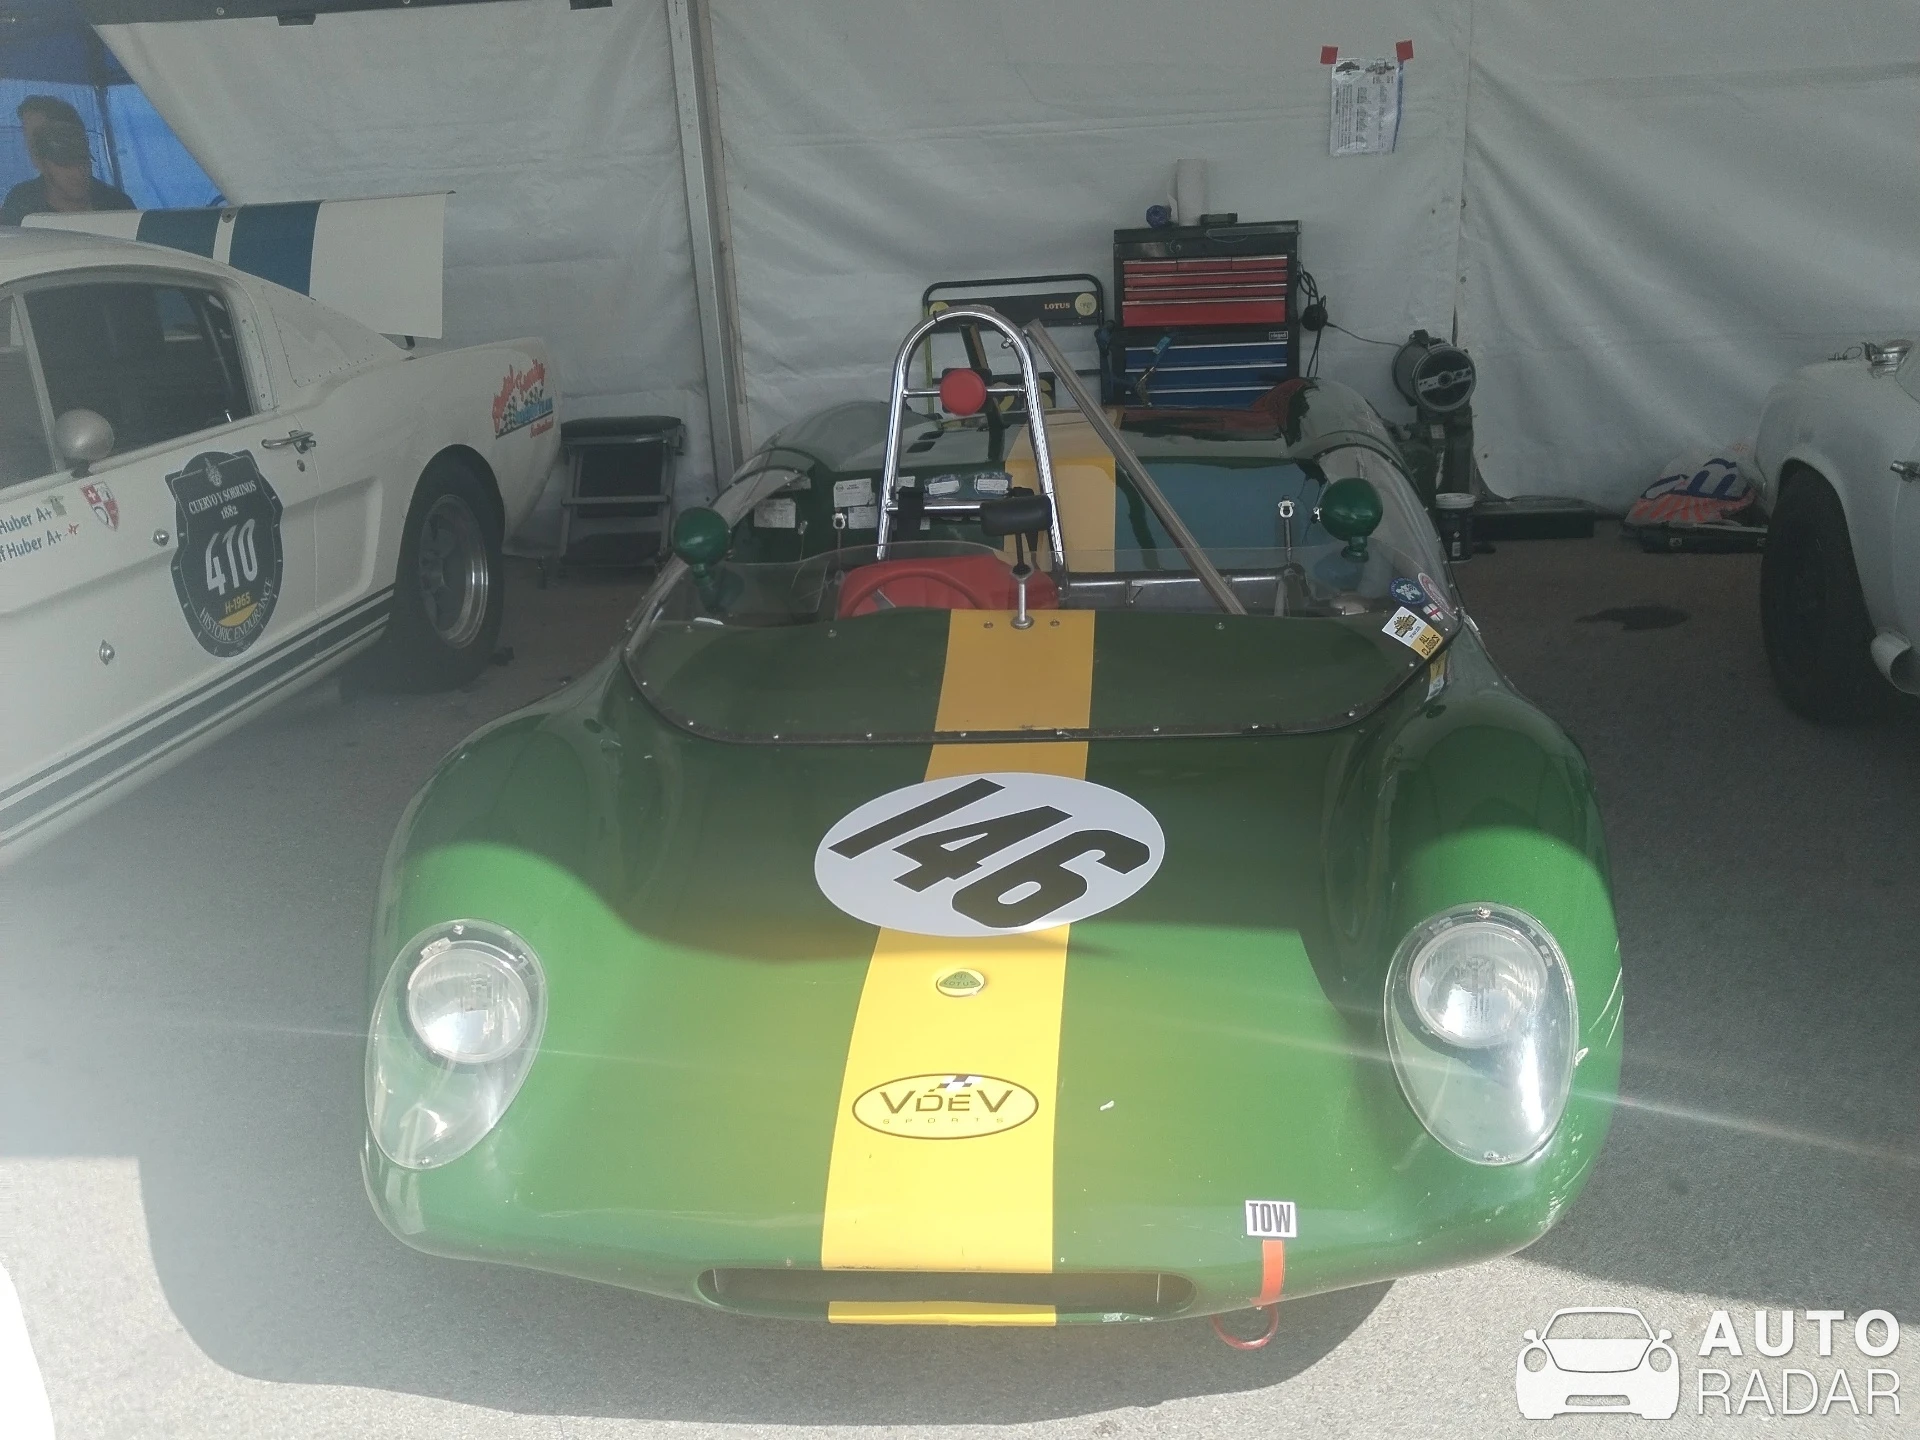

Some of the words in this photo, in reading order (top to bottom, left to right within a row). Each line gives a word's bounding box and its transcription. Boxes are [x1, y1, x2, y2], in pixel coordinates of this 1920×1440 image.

[1044, 302, 1070, 310] LOTUS
[188, 492, 218, 514] CUERVO
[223, 480, 257, 502] SOBRINOS
[36, 507, 52, 522] A+
[221, 505, 238, 519] 1882
[6, 537, 42, 559] Huber
[46, 530, 62, 546] A+
[206, 519, 258, 595] 410
[200, 607, 231, 641] HISTORIC
[234, 577, 273, 640] ENDURANCE
[224, 592, 251, 614] H-1965
[1419, 635, 1430, 645] ALL
[827, 777, 1151, 929] 146
[882, 1116, 1005, 1125] SPORTS
[1249, 1203, 1291, 1232] TOW
